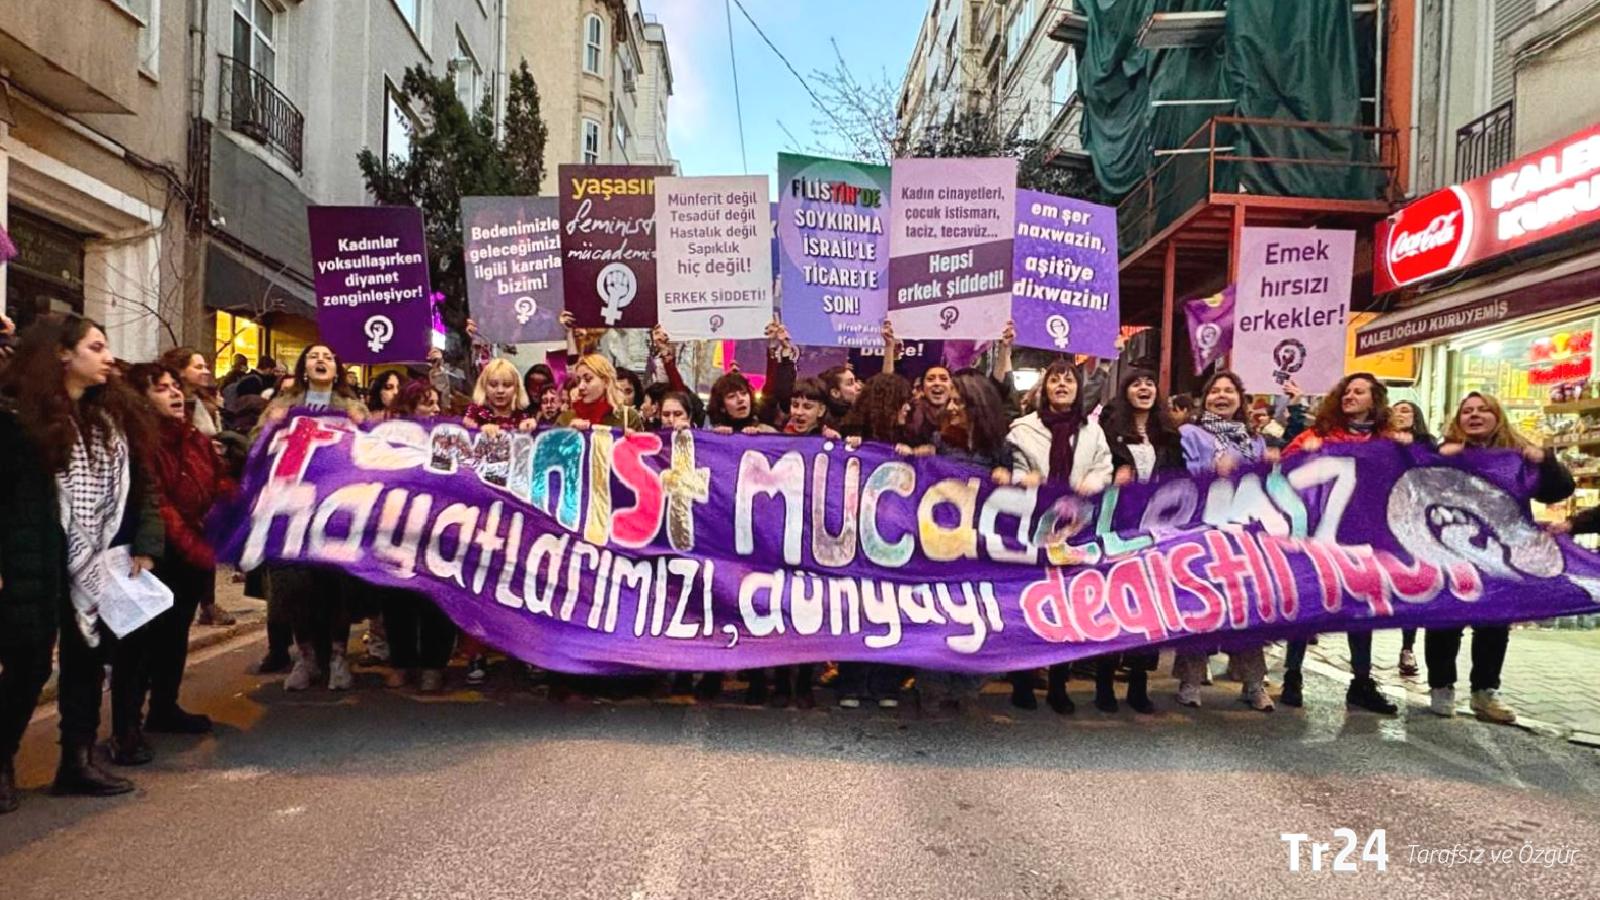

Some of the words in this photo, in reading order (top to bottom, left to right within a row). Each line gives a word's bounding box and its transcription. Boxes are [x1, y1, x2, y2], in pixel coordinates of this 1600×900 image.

[668, 191, 722, 207] Münferit
[726, 191, 757, 207] değil
[901, 187, 934, 200] Kadın
[938, 186, 1005, 201] cinayetleri,
[670, 208, 720, 222] Tesadüf
[725, 208, 755, 223] değil
[795, 209, 883, 234] SOYKIRIMA
[905, 206, 941, 221] çocuk
[945, 206, 1000, 221] istismarı,
[1031, 203, 1058, 218] em
[1062, 208, 1092, 226] şer
[471, 216, 560, 240] Bedenimizle
[670, 226, 721, 239] Hastalık
[726, 224, 757, 239] değil
[905, 225, 937, 239] taciz,
[941, 225, 998, 238] tecavüz...
[1017, 222, 1107, 254] naxwazin,
[1391, 209, 1461, 262] Coca-Cola
[338, 235, 400, 252] Kadınlar
[469, 234, 561, 263] geleceğimizl
[688, 241, 740, 256] Sapıklık
[803, 233, 876, 261] İSRAİL'LE
[1265, 238, 1329, 265] Emek
[317, 252, 422, 274] yoksullaşırken
[474, 260, 508, 281] ilgili
[512, 254, 562, 273] kararla
[677, 258, 700, 277] hiç
[705, 257, 751, 276] değil!
[929, 249, 974, 274] Hepsi
[1025, 255, 1094, 283] aşitîye
[345, 271, 400, 288] diyanet
[497, 273, 549, 295] bizim!
[803, 264, 878, 289] TİCARETE
[898, 279, 942, 304] erkek
[946, 269, 1005, 298] şiddeti!
[1260, 275, 1328, 298] hırsızı
[323, 285, 423, 307] zenginleşiyor!
[664, 291, 707, 304] ERKEK
[711, 287, 766, 305] ŞİDDETİ!
[823, 294, 860, 314] SON!
[1012, 278, 1110, 311] dixwazin!
[1239, 304, 1345, 331] erkekler!
[1360, 320, 1427, 349] KALELİOĞLU
[1428, 298, 1509, 331] KURUYEMİŞ
